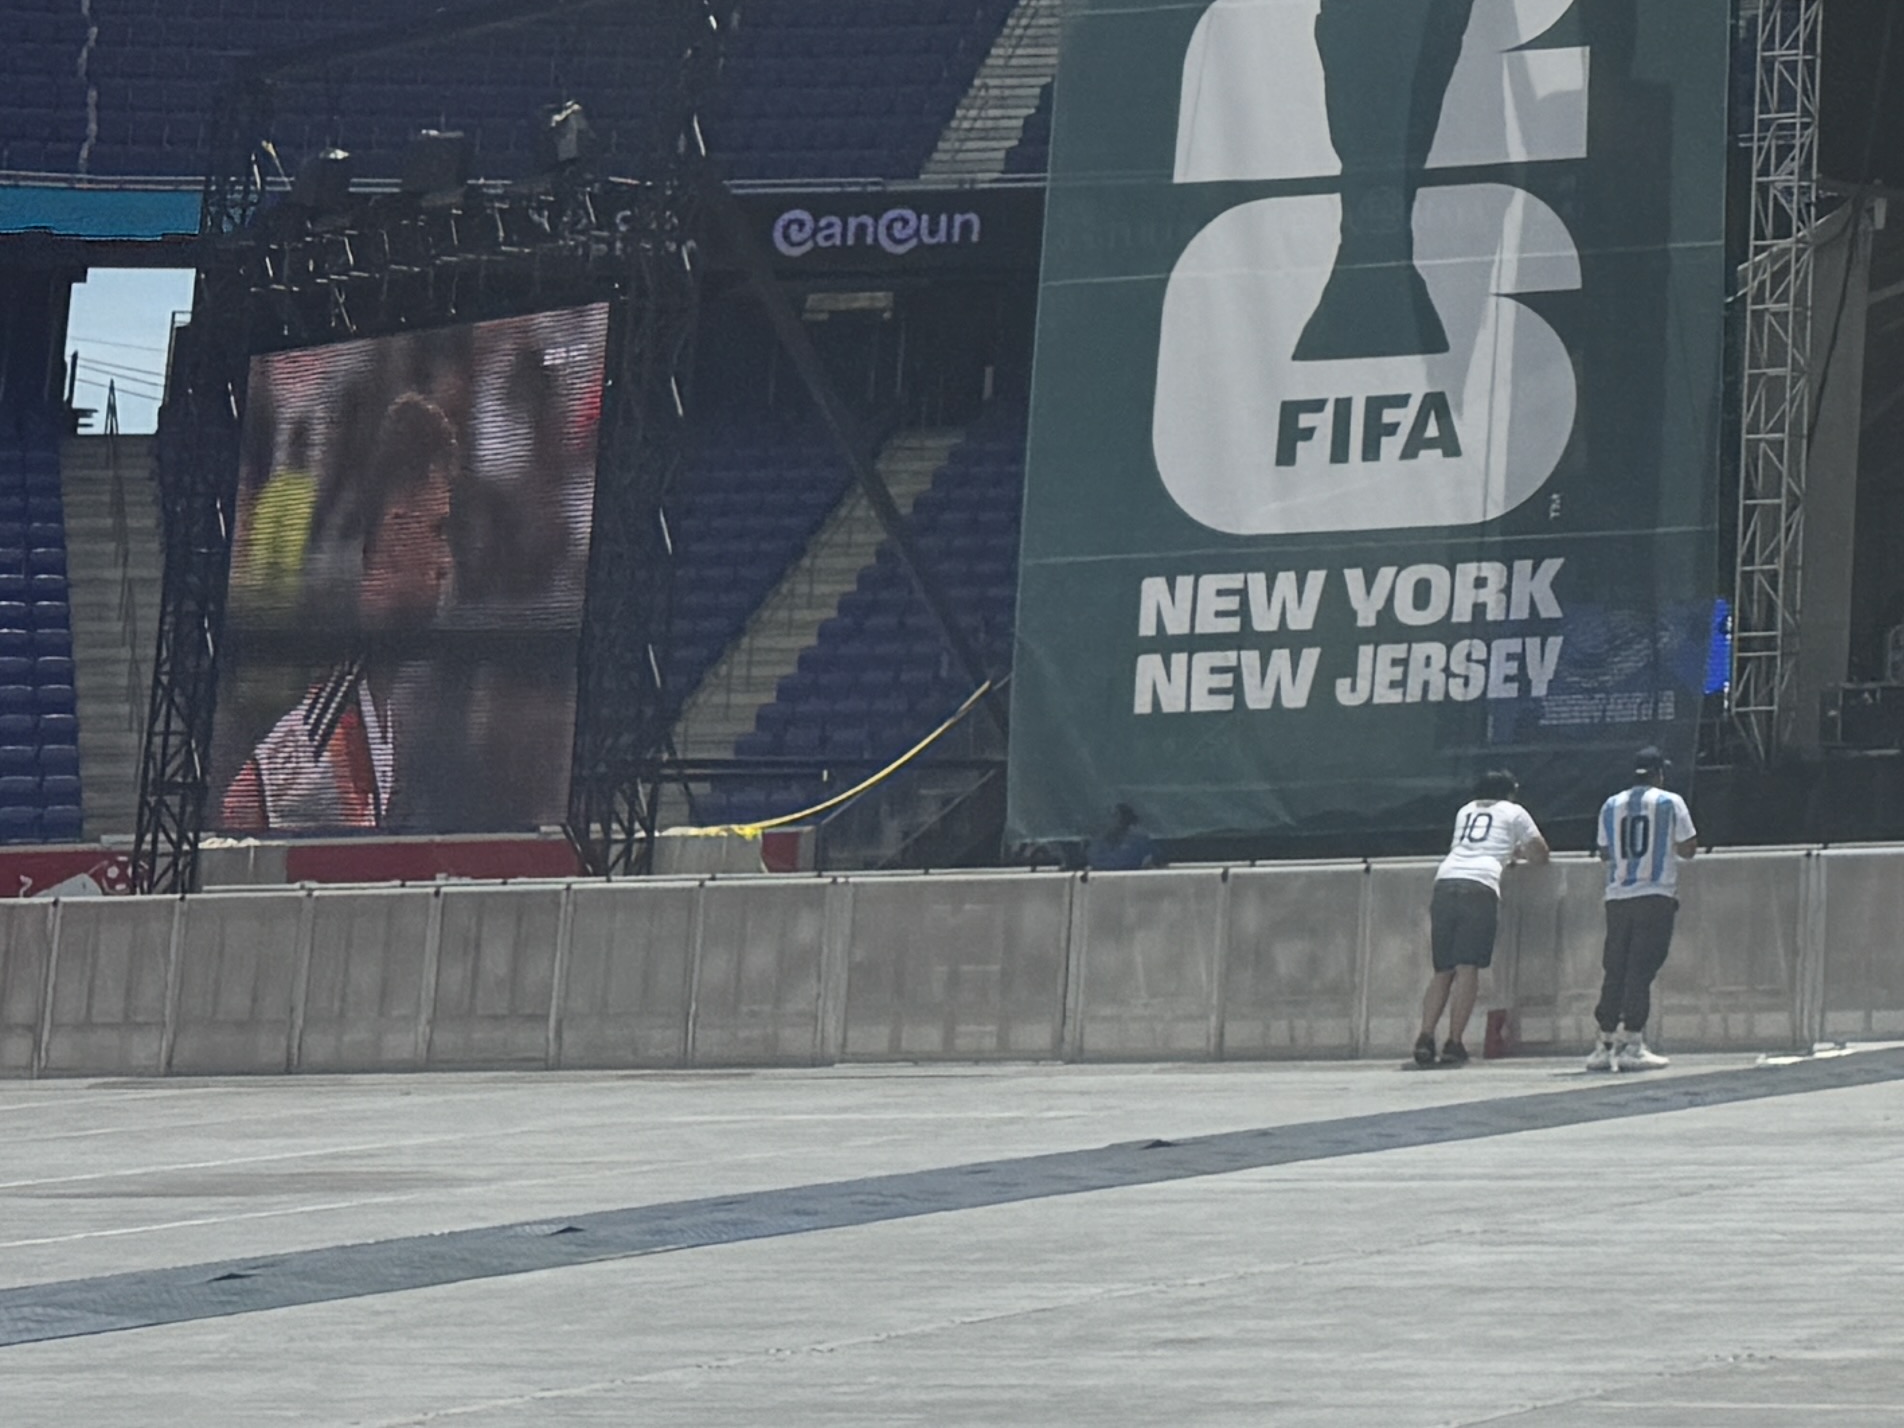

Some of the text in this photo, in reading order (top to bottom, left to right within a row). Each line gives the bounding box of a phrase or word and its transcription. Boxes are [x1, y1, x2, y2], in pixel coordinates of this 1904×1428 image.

[1274, 389, 1463, 469] FIFA
[1138, 557, 1565, 638] NEW YORK
[1133, 634, 1564, 715] NEW JERSEY
[1459, 811, 1493, 845] 10
[1620, 814, 1650, 860] 10
